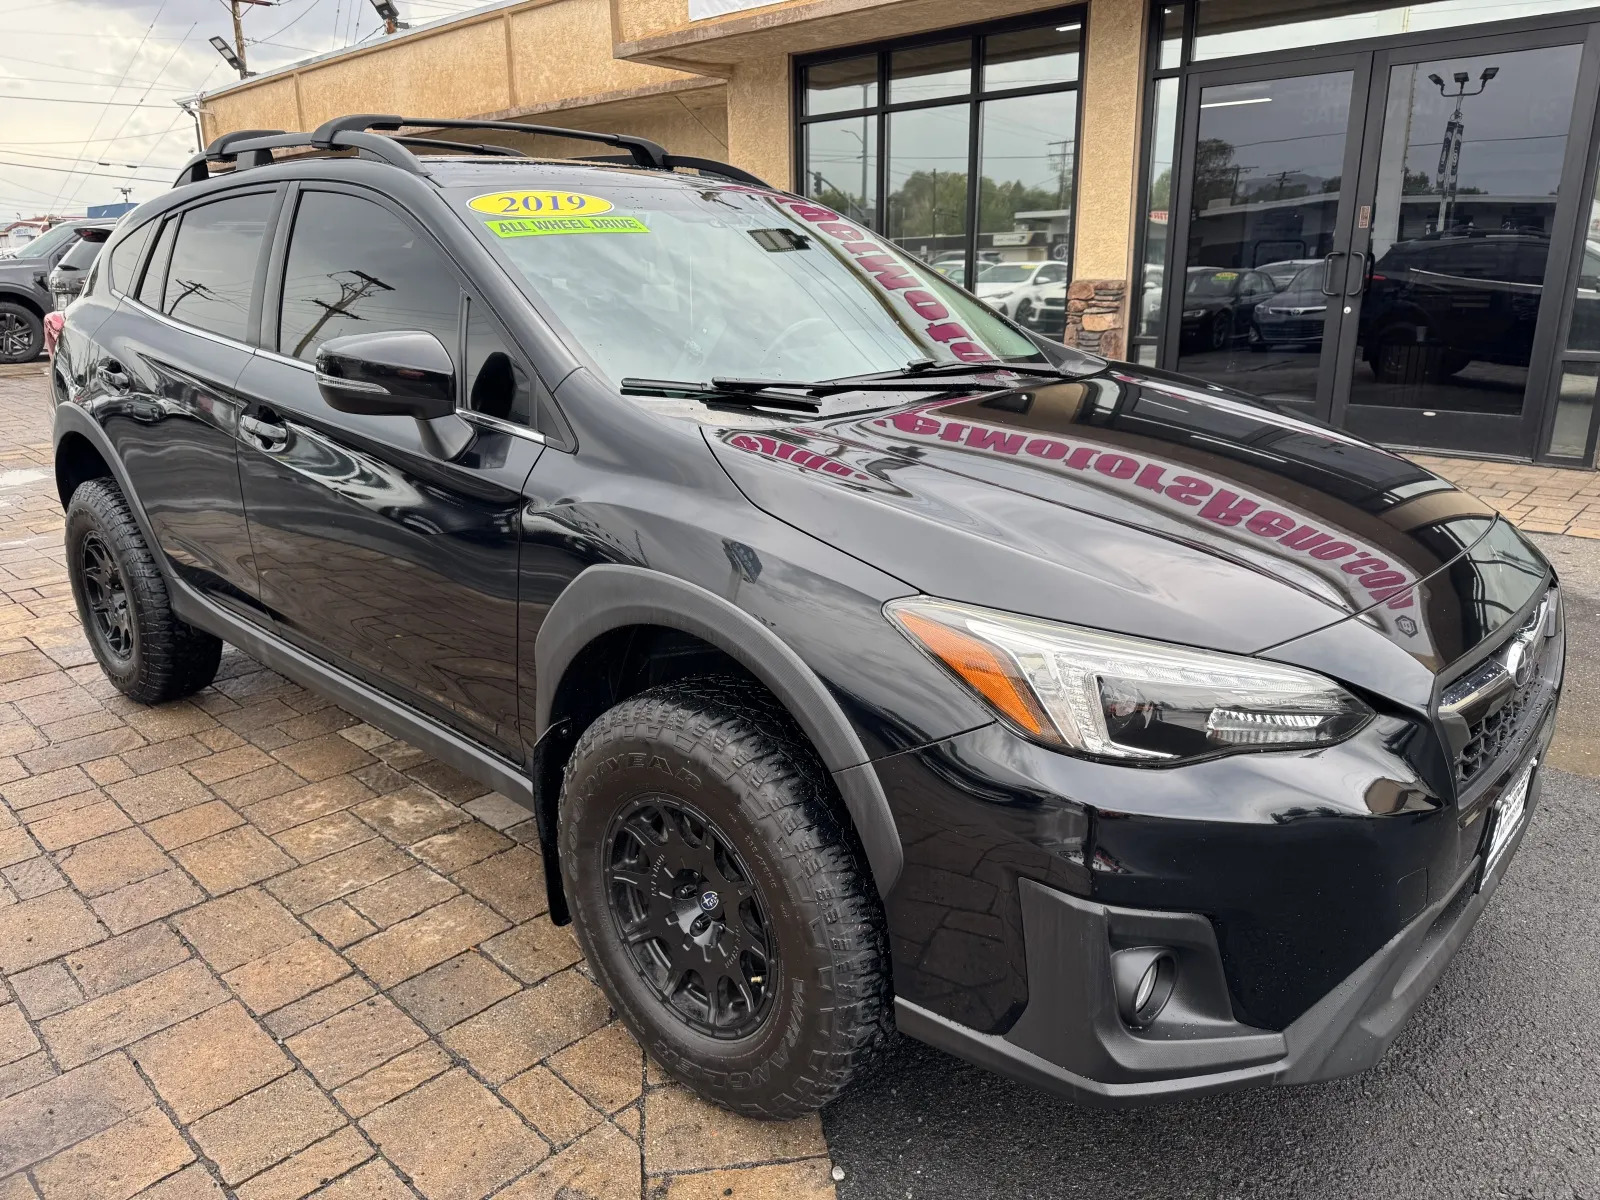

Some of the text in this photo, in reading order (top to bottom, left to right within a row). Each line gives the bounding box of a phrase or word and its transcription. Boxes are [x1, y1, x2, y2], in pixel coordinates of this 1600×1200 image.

[498, 195, 586, 213] 2019
[499, 218, 638, 233] ALL WHEEL DRIVE
